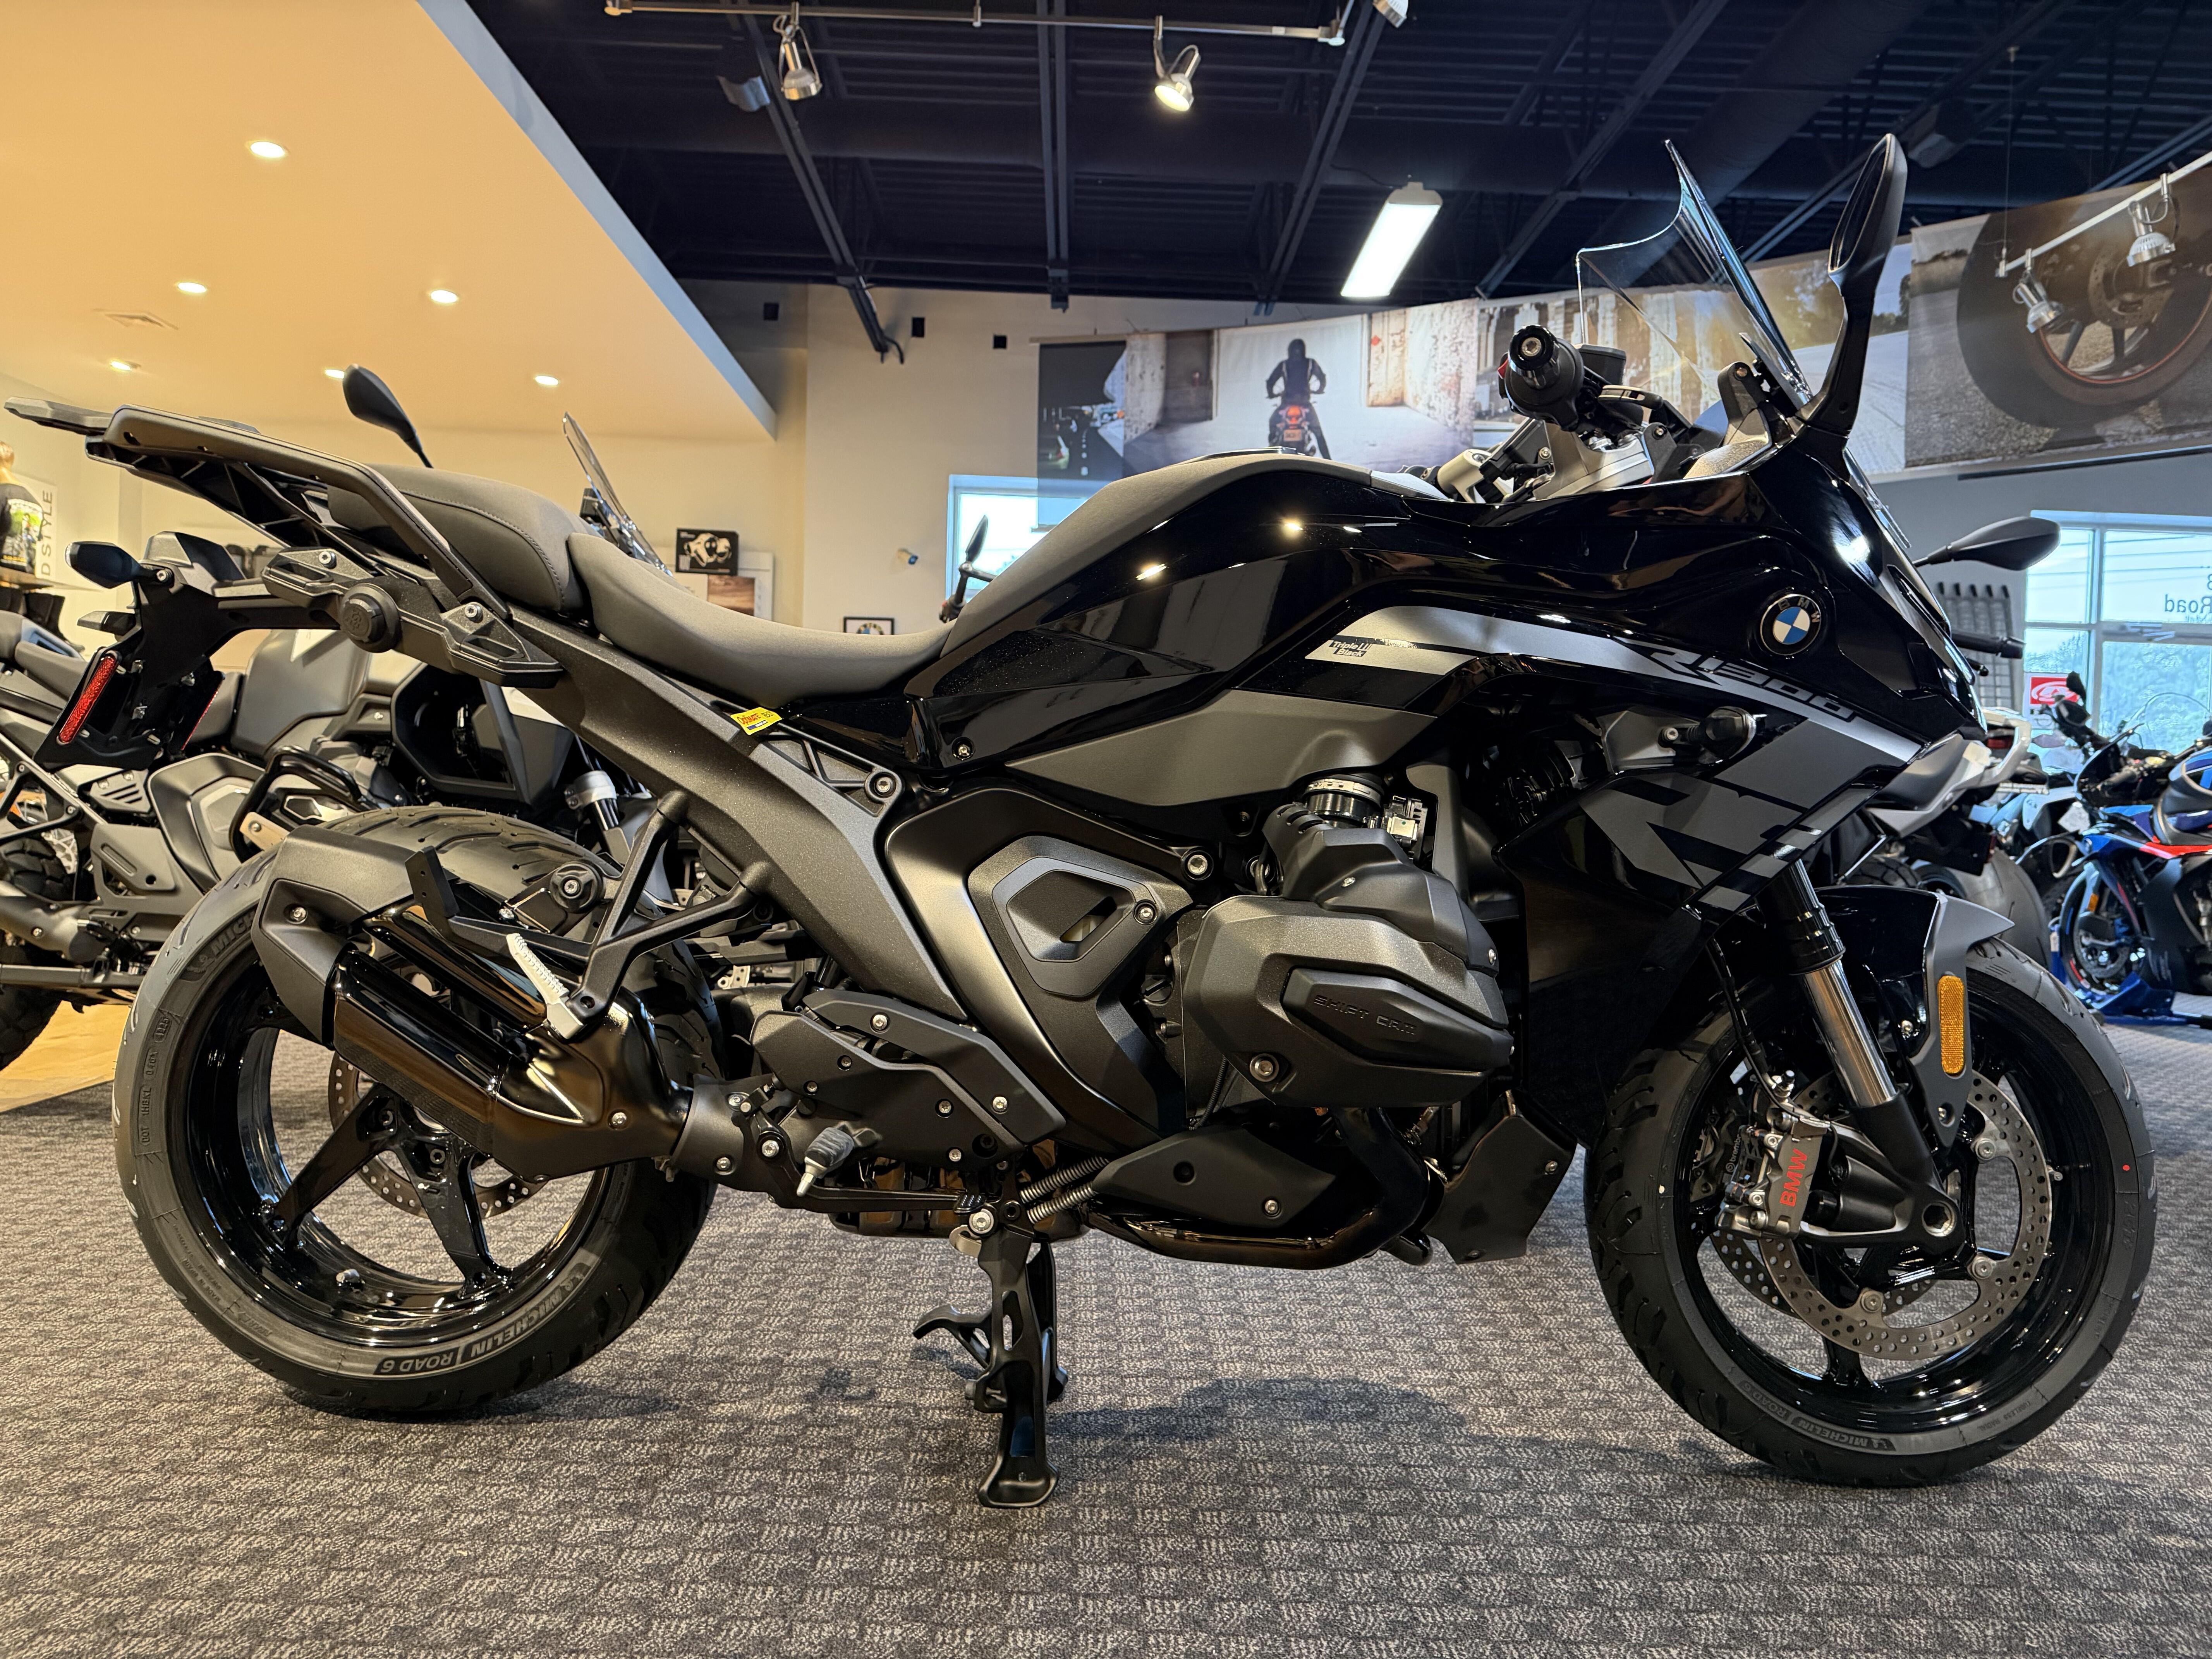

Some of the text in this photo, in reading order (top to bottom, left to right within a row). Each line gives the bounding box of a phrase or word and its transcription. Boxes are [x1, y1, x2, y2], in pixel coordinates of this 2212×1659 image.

[1778, 596, 1820, 623] BMW
[1333, 641, 1358, 651] Triple
[1336, 648, 1364, 657] Black
[1314, 994, 1369, 1020] SHIFT
[141, 1125, 150, 1143] DOT
[1779, 1148, 1807, 1207] BMW
[381, 1287, 562, 1373] MICHELIN ROAD 6
[1753, 1391, 1788, 1418] ROAD
[1798, 1416, 1869, 1448] MICHELIN
